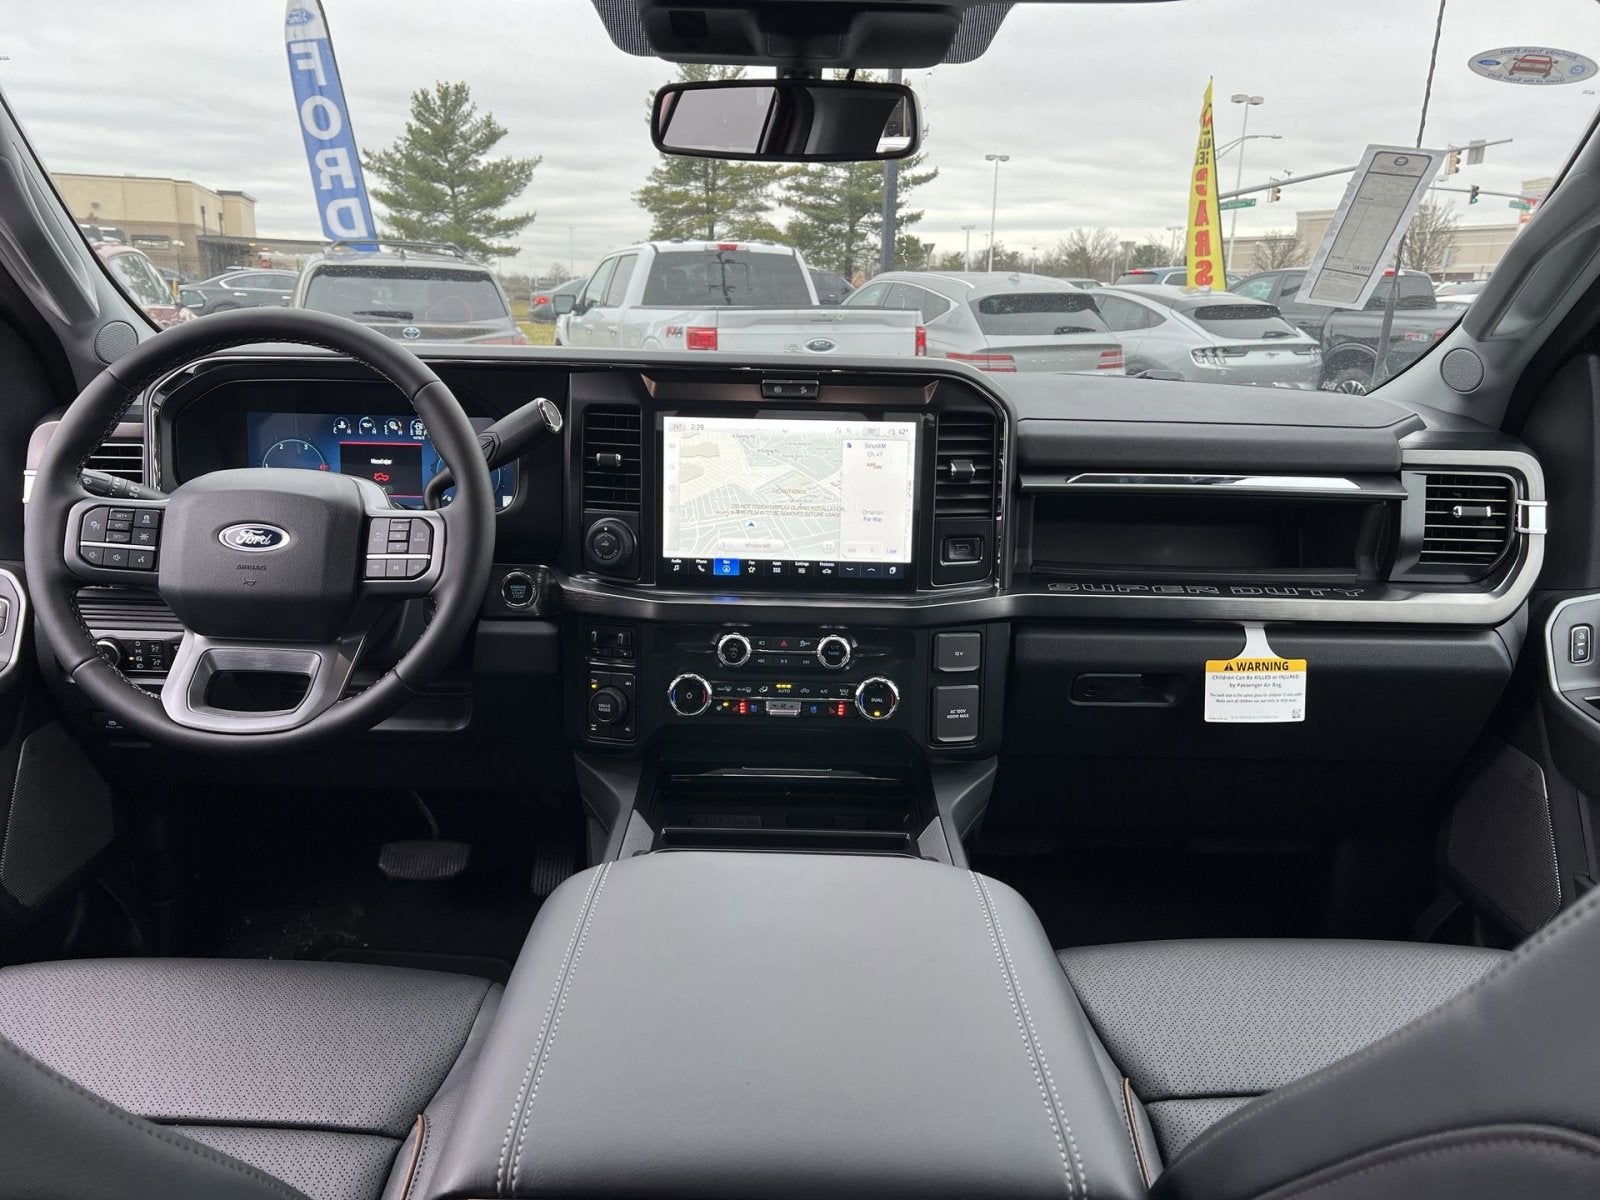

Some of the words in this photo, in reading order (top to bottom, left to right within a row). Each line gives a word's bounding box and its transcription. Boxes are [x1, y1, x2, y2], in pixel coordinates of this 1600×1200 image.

[235, 529, 273, 545] Ford
[1047, 582, 1220, 594] SUPER
[1230, 586, 1365, 597] DUTY
[1236, 662, 1289, 671] WARNING
